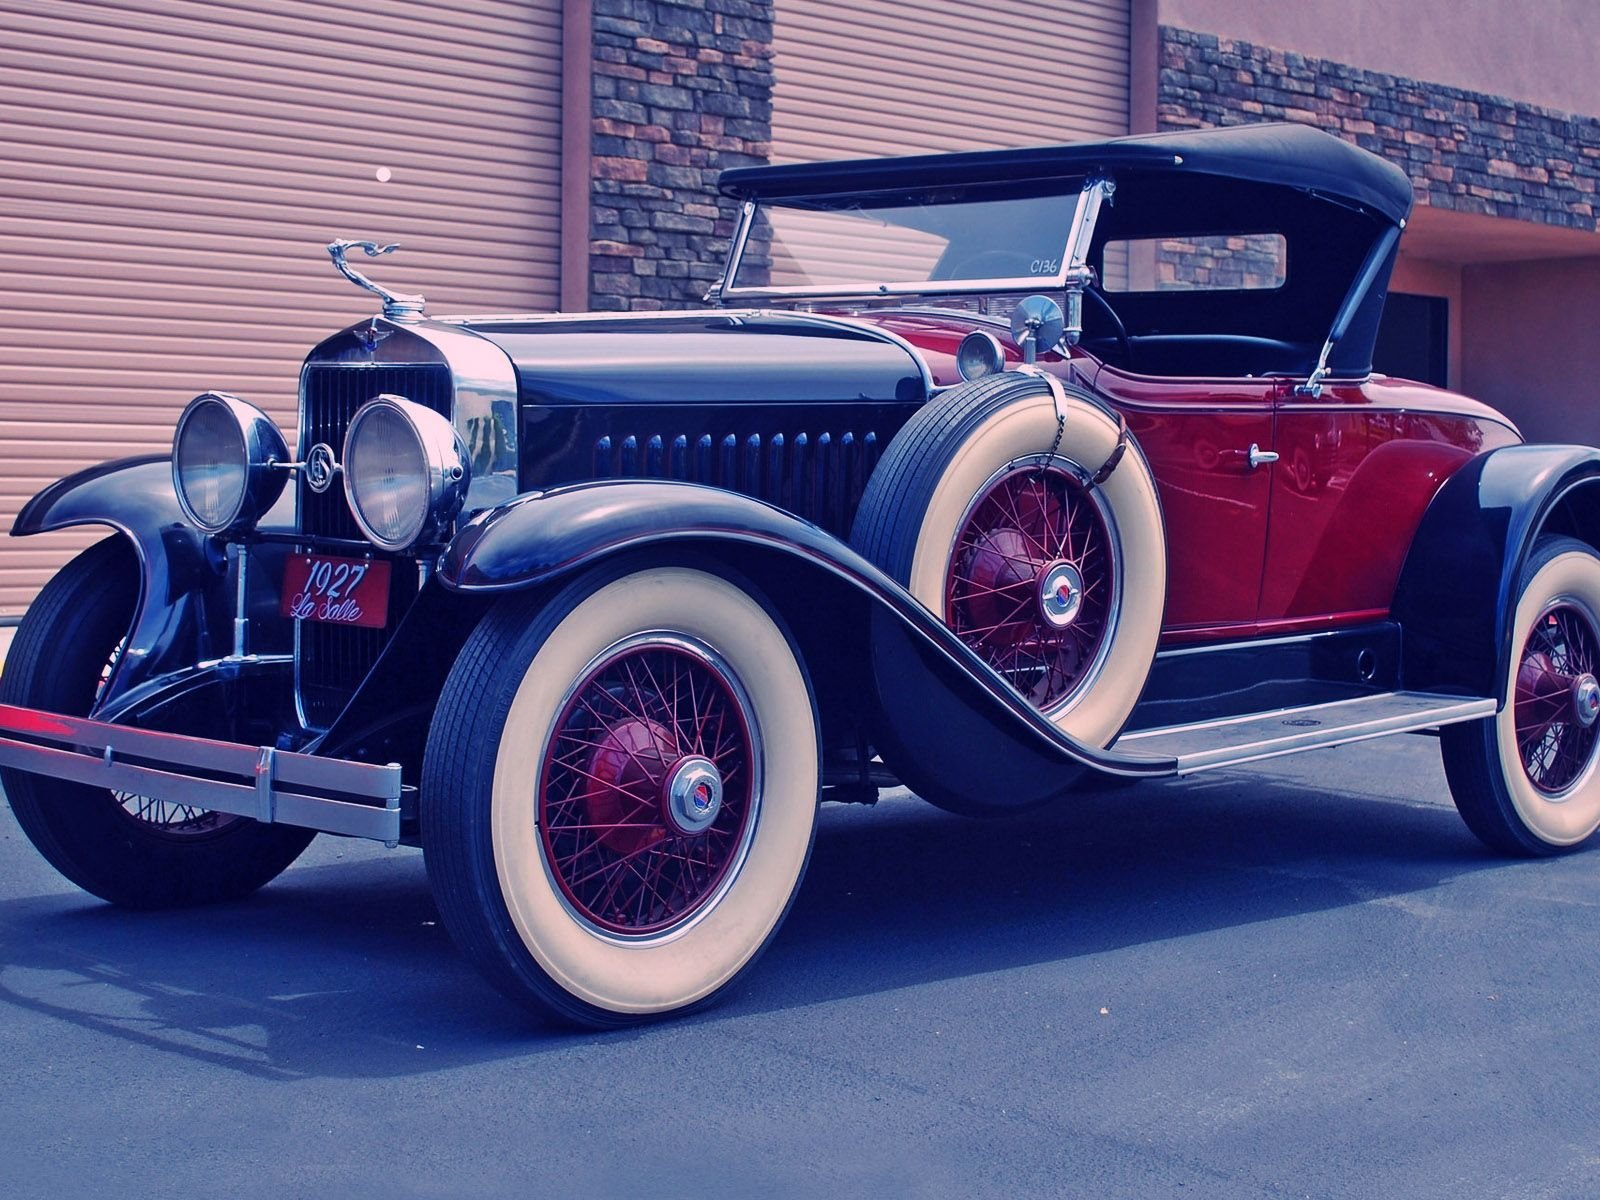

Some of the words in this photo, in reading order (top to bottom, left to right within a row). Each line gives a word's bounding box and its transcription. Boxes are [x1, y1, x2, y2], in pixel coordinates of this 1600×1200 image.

[1030, 259, 1057, 273] C136
[304, 561, 365, 597] 1927
[290, 593, 317, 619] La
[319, 596, 363, 621] Salle
